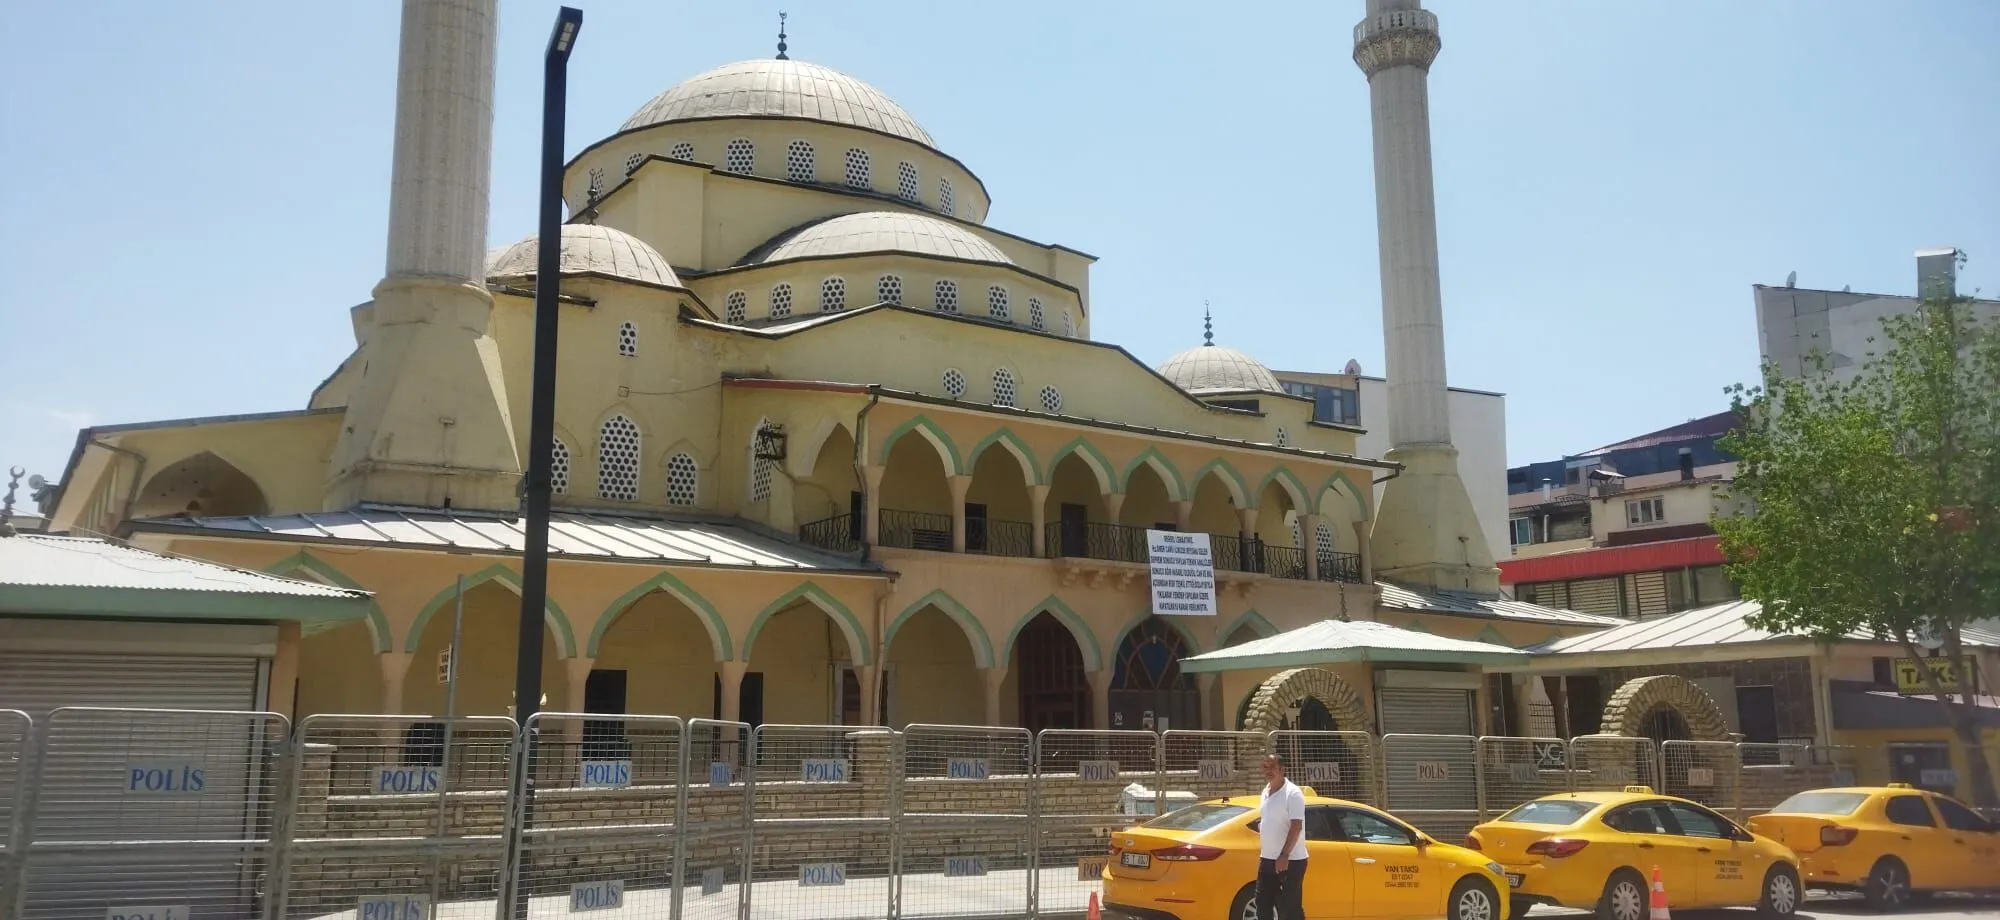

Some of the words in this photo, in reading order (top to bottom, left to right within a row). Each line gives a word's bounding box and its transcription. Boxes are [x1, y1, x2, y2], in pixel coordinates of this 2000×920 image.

[585, 761, 628, 784] POLİS
[806, 759, 843, 781] POLİS
[951, 760, 985, 778] POLİS
[1084, 764, 1116, 781] POLİS
[1200, 763, 1229, 779] POLİS
[1307, 765, 1339, 781] POLİS
[1419, 762, 1445, 779] POLİS
[130, 765, 204, 792] POLİS
[380, 767, 438, 792] POLİS
[803, 864, 843, 884] POLİS
[949, 859, 983, 876] POLİS
[1083, 862, 1103, 878] POL
[1385, 864, 1399, 873] VAN
[575, 882, 619, 909] POLİS
